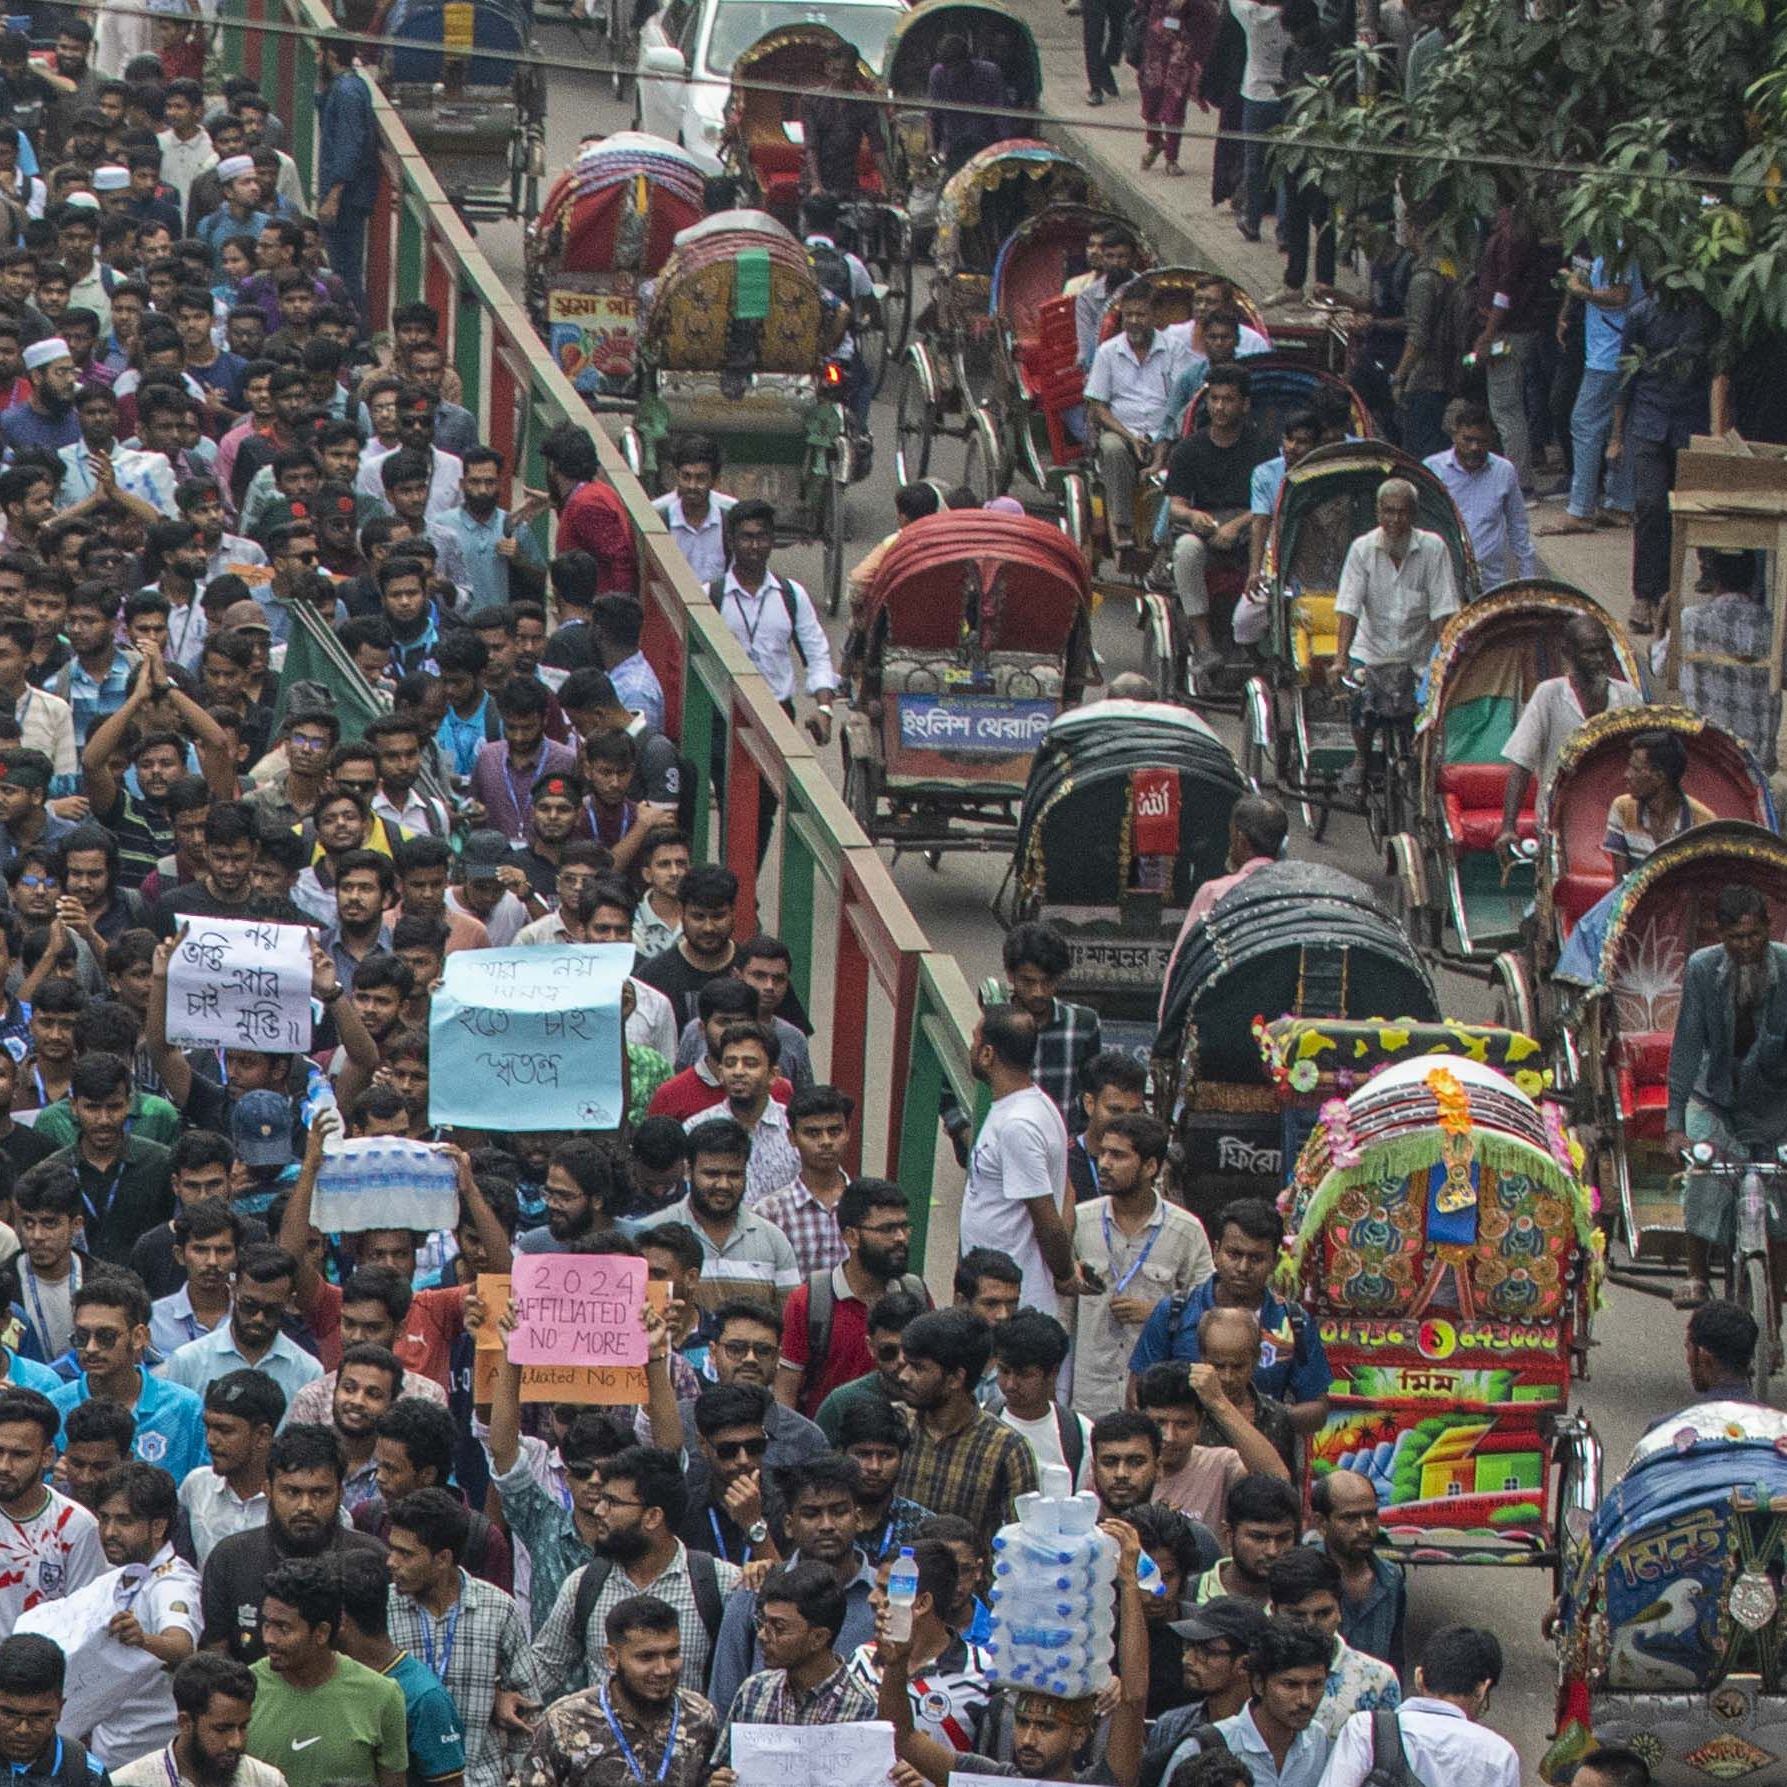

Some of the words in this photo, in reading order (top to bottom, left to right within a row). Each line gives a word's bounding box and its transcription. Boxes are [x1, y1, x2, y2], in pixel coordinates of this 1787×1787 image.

[515, 1298, 628, 1326] AFFILIATED
[530, 1328, 558, 1351] NO
[576, 1330, 632, 1357] MORE
